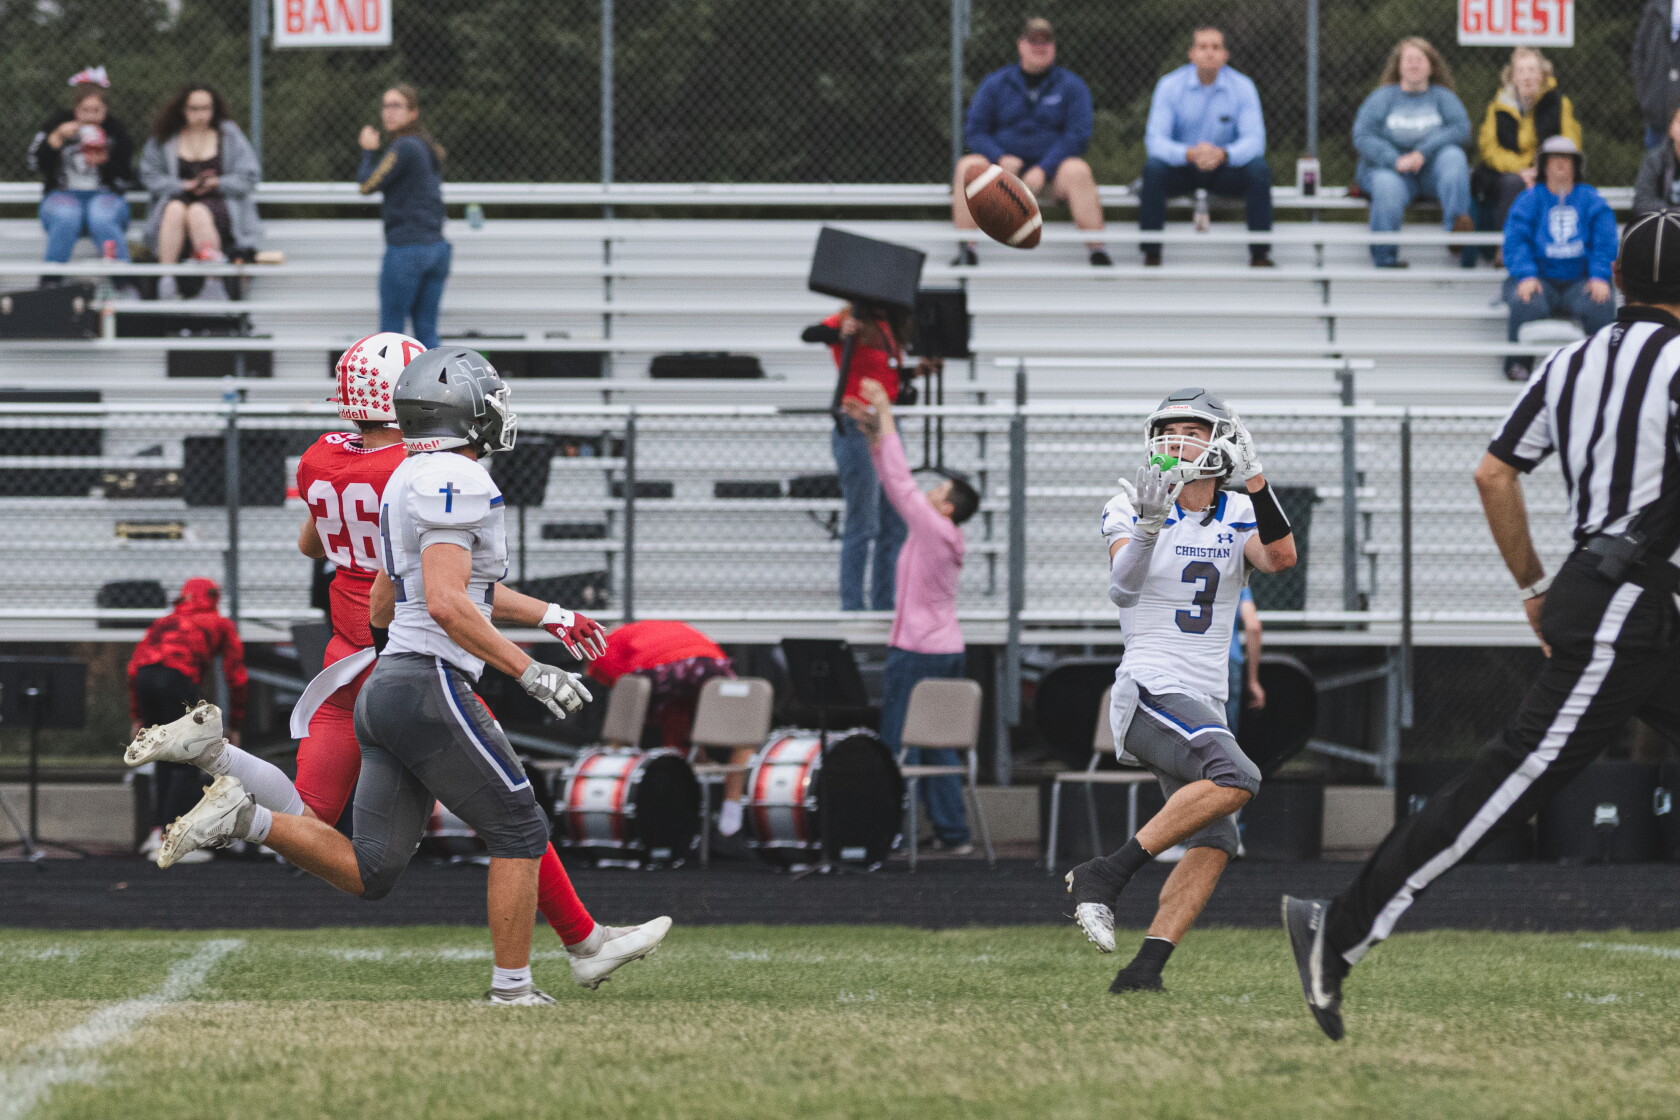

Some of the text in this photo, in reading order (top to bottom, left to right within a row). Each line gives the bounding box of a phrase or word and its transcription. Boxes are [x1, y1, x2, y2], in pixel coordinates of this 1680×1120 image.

[285, 0, 382, 33] BAND
[1461, 0, 1572, 34] GUEST
[307, 479, 384, 573] 26
[1175, 545, 1231, 559] CHRISTIAN
[1175, 560, 1221, 635] 3
